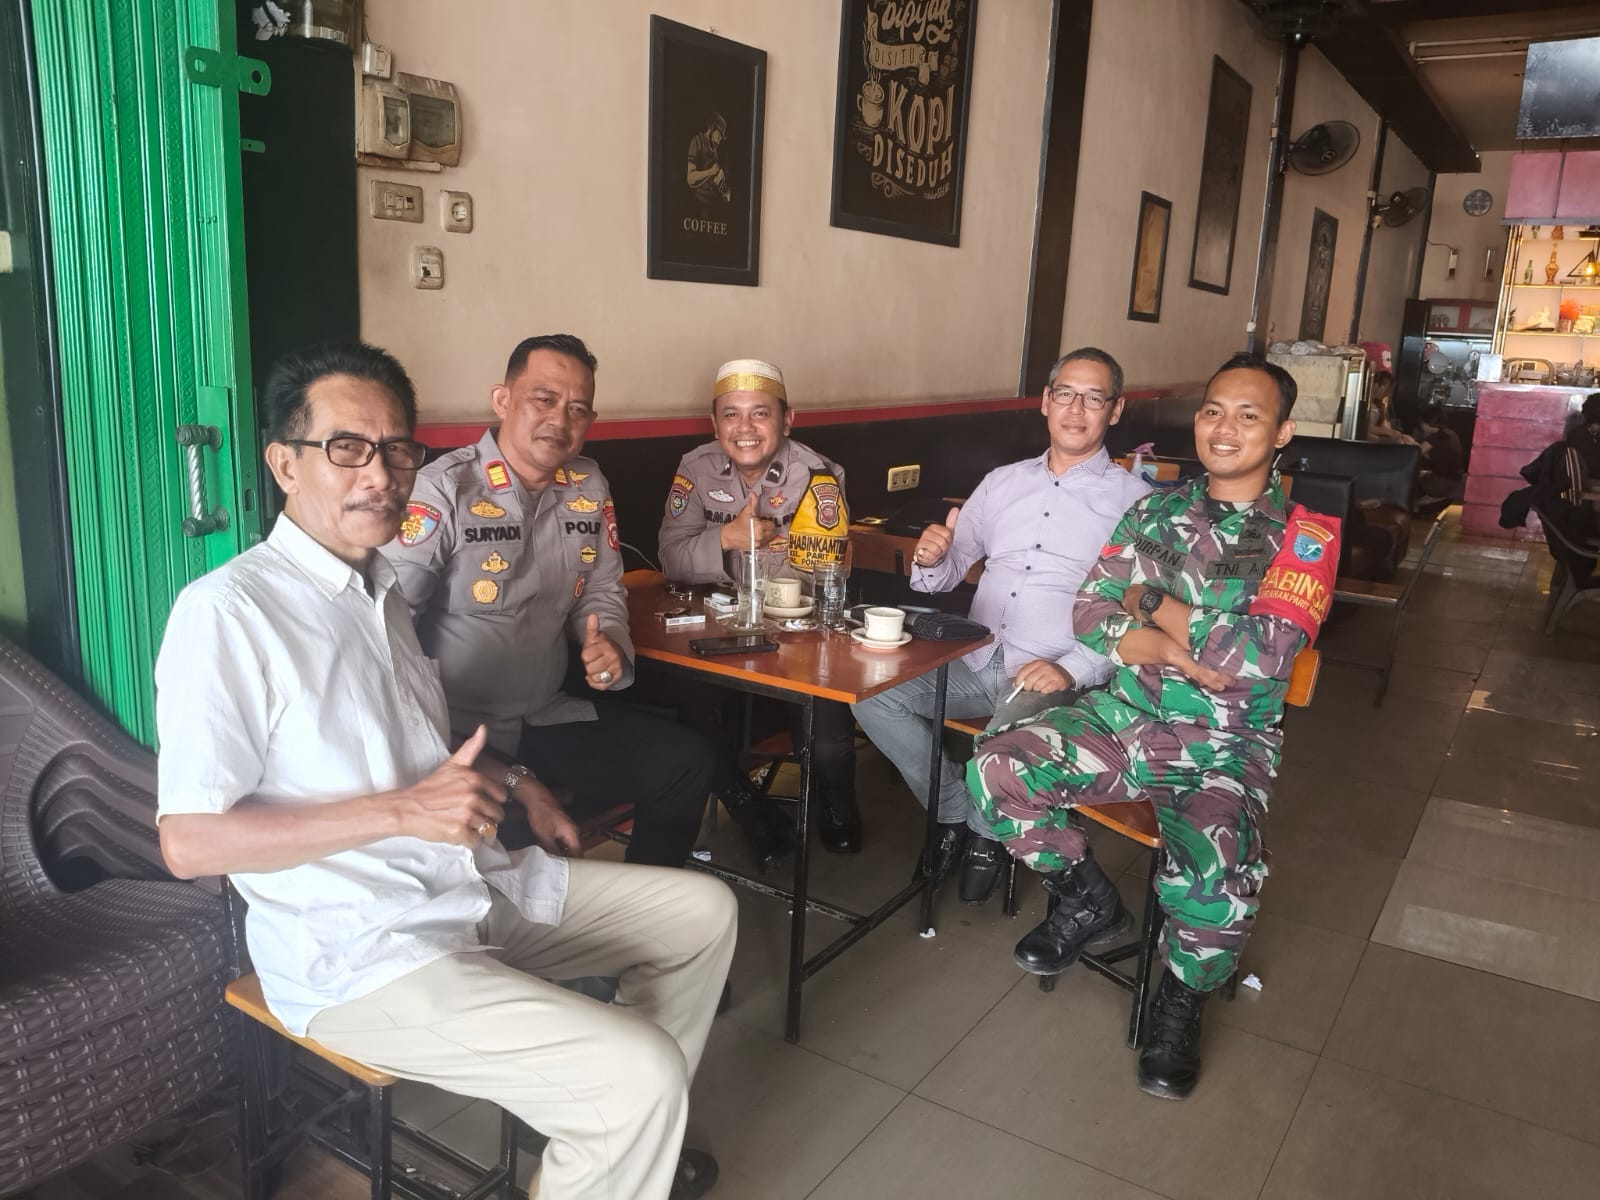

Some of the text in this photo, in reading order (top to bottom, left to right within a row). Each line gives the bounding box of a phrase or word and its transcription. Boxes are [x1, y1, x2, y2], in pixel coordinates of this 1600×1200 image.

[887, 80, 955, 155] KOPI
[872, 133, 954, 188] DISEDUH
[683, 217, 727, 236] COFFEE
[465, 526, 521, 543] SURYADI
[806, 551, 829, 561] PARIT
[1215, 563, 1240, 576] TNI
